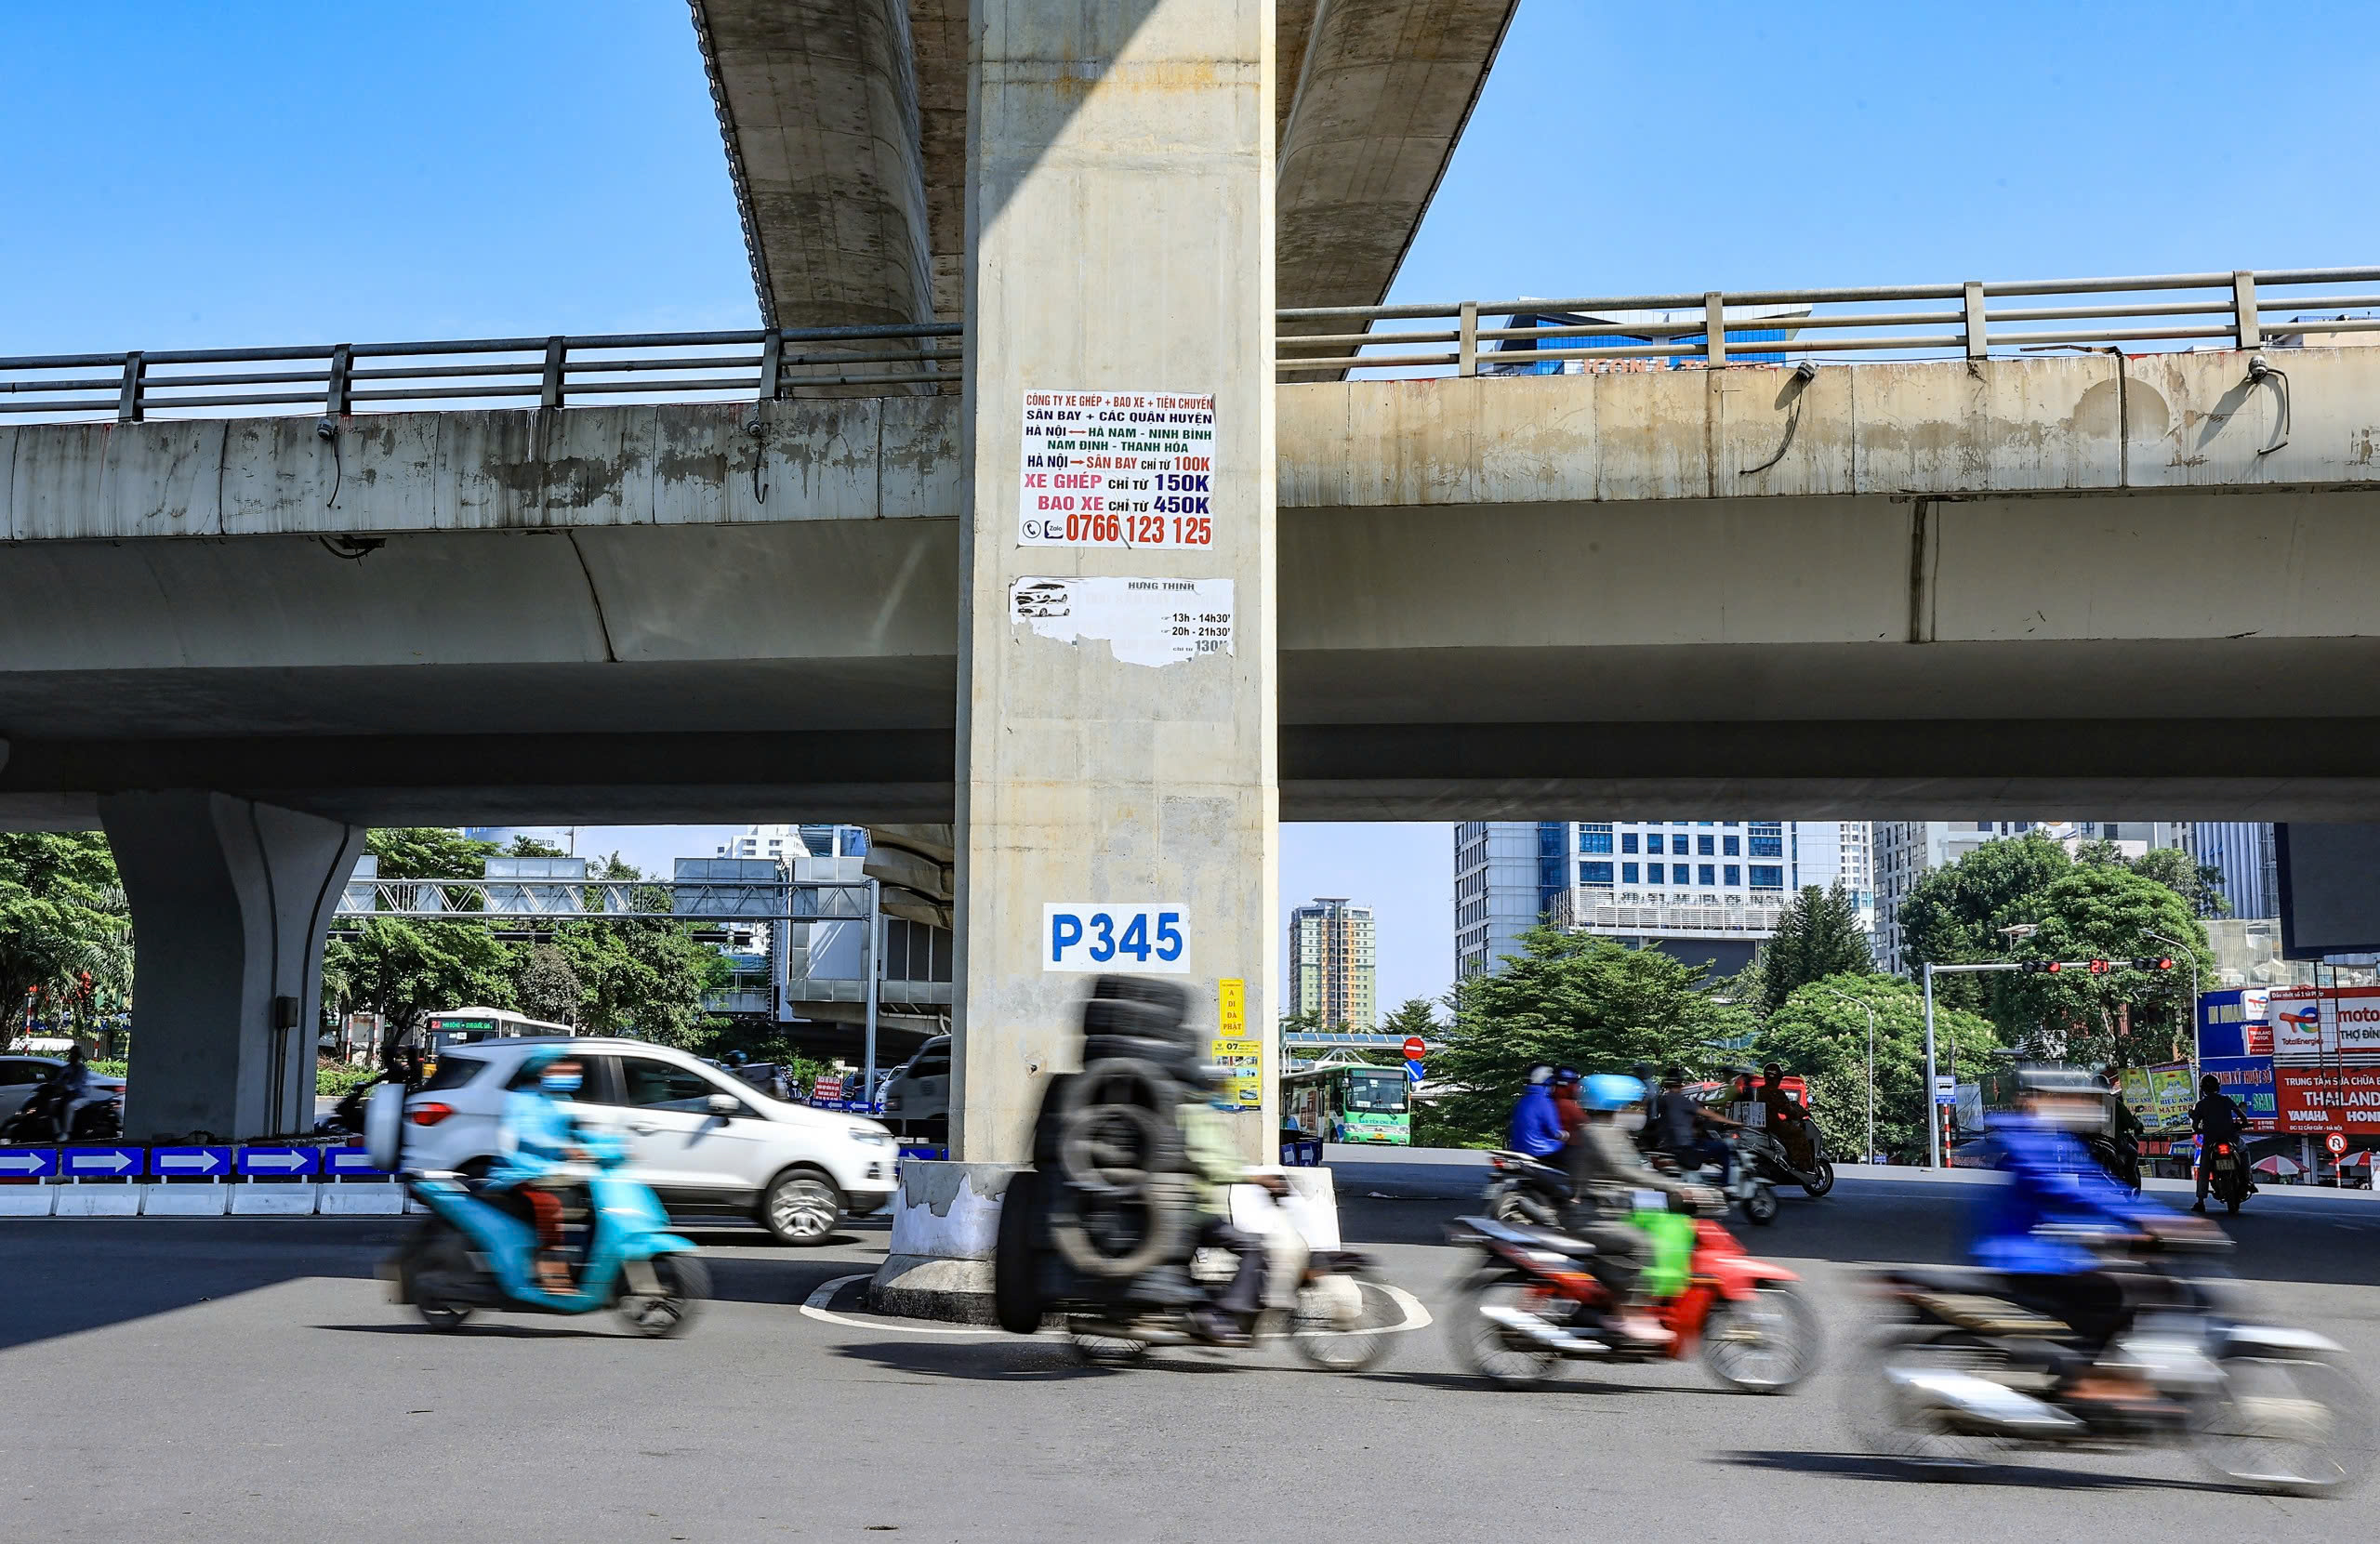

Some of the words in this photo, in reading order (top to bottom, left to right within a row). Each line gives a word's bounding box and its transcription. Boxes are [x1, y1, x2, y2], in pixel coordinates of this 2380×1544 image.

[1026, 393, 1051, 406] CÔNG
[1052, 395, 1064, 406] TY
[1065, 396, 1077, 406] XE
[1079, 394, 1102, 406] GHÉP
[1114, 396, 1131, 407] BAO
[1133, 397, 1144, 407] XE
[1157, 395, 1175, 411] TIỆN
[1178, 395, 1213, 410] CHUYẾN
[1026, 409, 1053, 420] SÂN
[1057, 411, 1081, 420] BAY
[1099, 410, 1125, 421] CÁC
[1130, 411, 1165, 425] QUẬN
[1169, 412, 1212, 426] HUYỆN
[1025, 425, 1041, 436] HÀ
[1046, 425, 1066, 438] NỘI
[1088, 426, 1104, 437] HÀ
[1108, 428, 1136, 438] NAM
[1148, 429, 1179, 439] NINH
[1183, 428, 1211, 440] BÌNH
[1048, 440, 1076, 450] NAM
[1079, 441, 1109, 452] ĐỊNH
[1121, 442, 1160, 452] THANH
[1164, 442, 1189, 453] HÓA
[1027, 453, 1043, 468] HÀ
[1048, 453, 1068, 470] NỘI
[1086, 454, 1111, 468] SÂN
[1115, 456, 1137, 469] BAY
[1141, 457, 1157, 470] CHỈ
[1158, 459, 1171, 470] TỪ
[1174, 456, 1210, 471] 100K
[1025, 473, 1047, 488] XE
[1053, 471, 1102, 489] GHÉP
[1108, 477, 1129, 490] CHỈ
[1132, 478, 1149, 490] TỪ
[1155, 473, 1210, 492] 150K
[1038, 495, 1075, 510] BAO
[1080, 496, 1104, 510] XE
[1108, 498, 1130, 511] CHỈ
[1132, 500, 1149, 512] TỪ
[1153, 495, 1210, 514] 450K
[1066, 514, 1118, 542] 0766
[1126, 515, 1165, 544] 123
[1172, 517, 1211, 545] 125
[1128, 581, 1158, 589] HƯNG
[1162, 582, 1195, 591] THỊNH
[1172, 613, 1190, 622] 13h
[1171, 627, 1190, 636] 20h
[528, 838, 555, 848] OWER
[1051, 912, 1183, 962] P345
[2092, 959, 2108, 972] 21
[2338, 1007, 2380, 1023] moto
[2340, 1028, 2360, 1041] THỢ
[2362, 1026, 2380, 1039] ĐỈN
[2284, 1077, 2313, 1086] TRUNG
[2351, 1075, 2375, 1086] CHỮA
[2253, 1092, 2275, 1112] SCAN
[2302, 1091, 2380, 1106] THAILAND
[2288, 1110, 2329, 1122] YAMAHA
